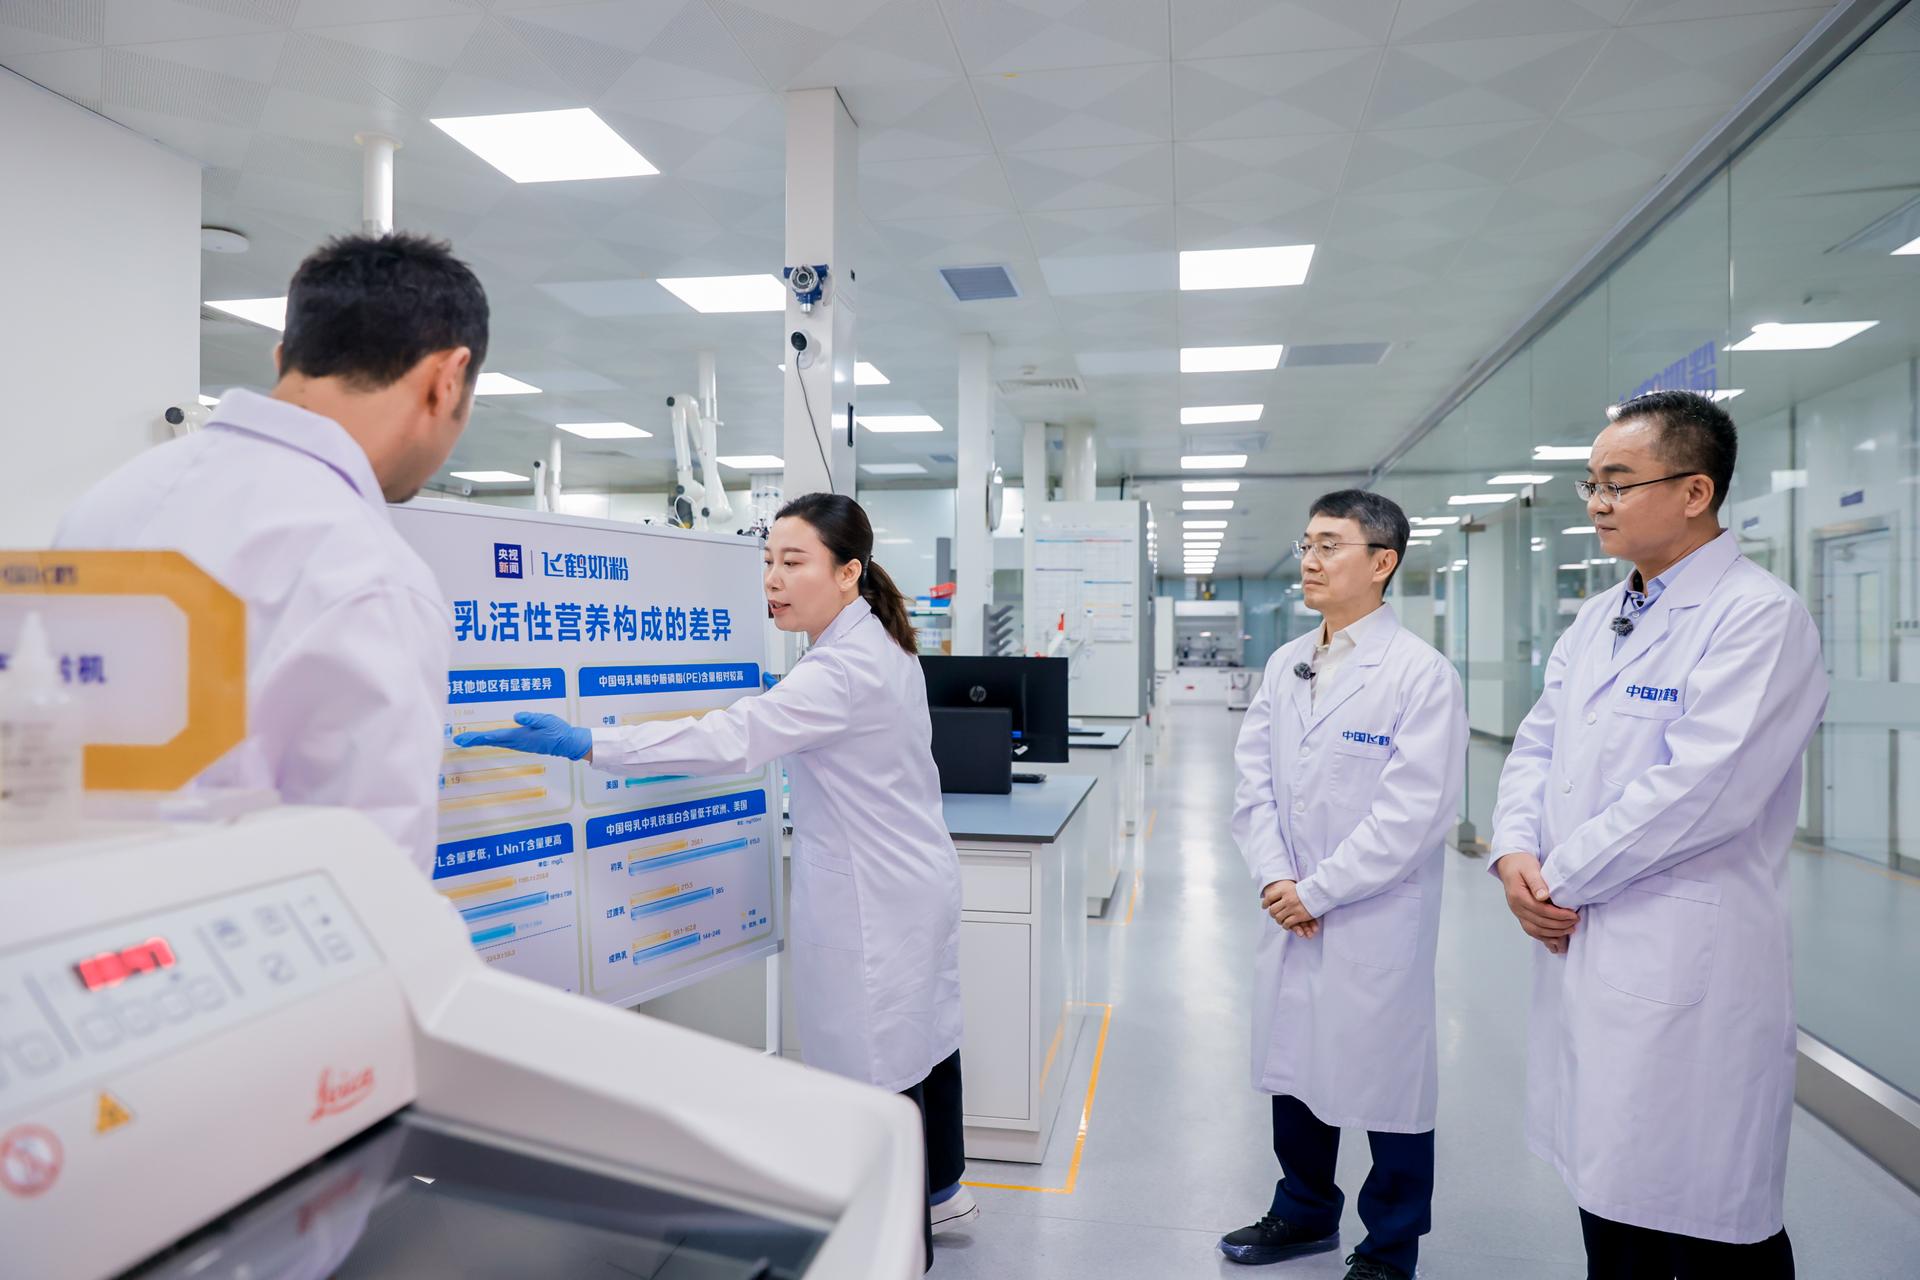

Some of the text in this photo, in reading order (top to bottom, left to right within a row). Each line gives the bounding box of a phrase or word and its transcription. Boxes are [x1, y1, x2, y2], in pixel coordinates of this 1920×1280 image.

[498, 548, 519, 561] 央视
[499, 561, 519, 574] 新闻
[541, 551, 629, 581] 飞鹤奶粉
[453, 599, 732, 642] 乳活性营养构成的差异
[448, 676, 552, 695] 其他地区有显著差异
[1626, 684, 1679, 702] 中国鹤
[602, 715, 616, 725] 中国
[605, 779, 619, 790] 美国
[605, 799, 749, 837] 中国母乳中乳铁蛋白含量低于欧洲、美国
